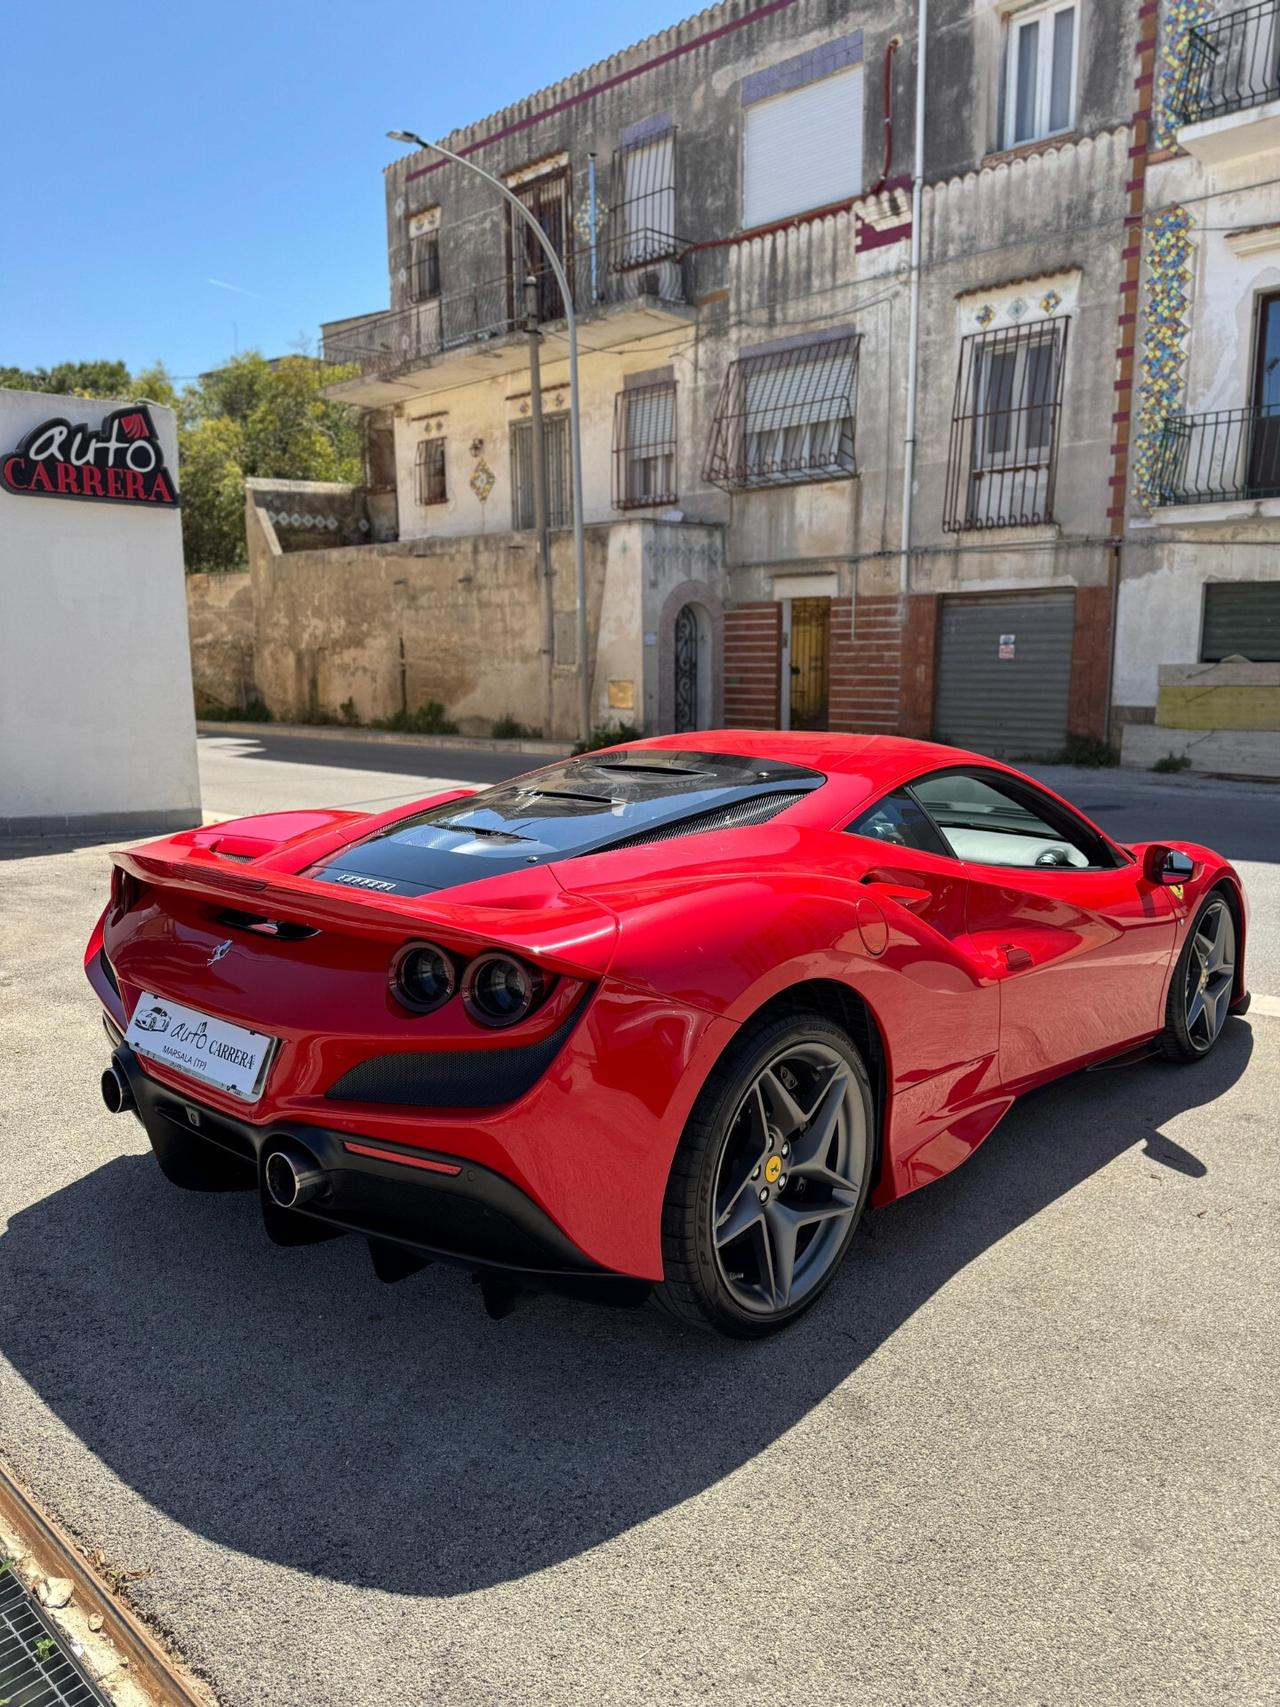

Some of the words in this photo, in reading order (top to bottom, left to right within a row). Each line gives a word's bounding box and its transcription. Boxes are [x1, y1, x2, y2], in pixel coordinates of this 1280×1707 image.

[29, 418, 156, 473] auto
[4, 457, 173, 502] CARRERA
[163, 1045, 193, 1064] MARSALA
[192, 1057, 208, 1072] (TP)
[170, 1021, 208, 1049] auto
[208, 1039, 253, 1070] CARRERA
